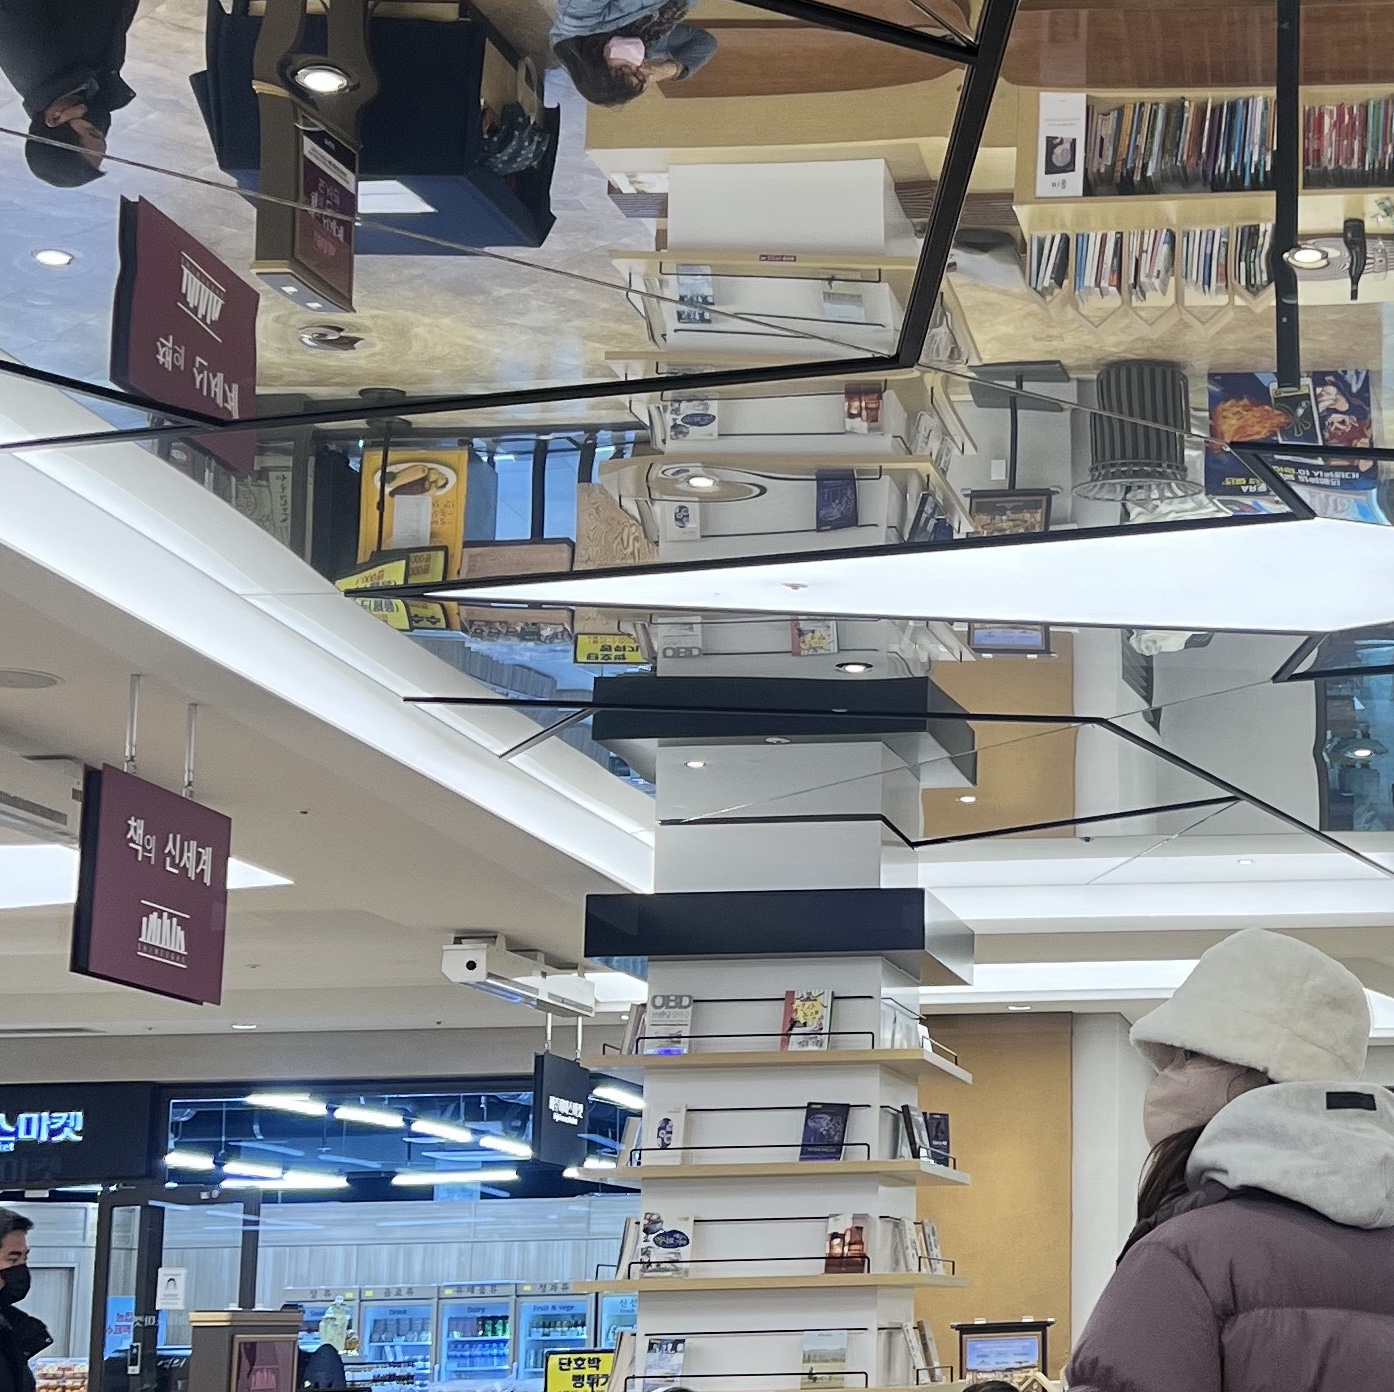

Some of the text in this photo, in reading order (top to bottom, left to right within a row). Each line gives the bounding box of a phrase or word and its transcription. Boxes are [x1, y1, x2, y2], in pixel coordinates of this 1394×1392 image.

[127, 816, 213, 886] 책의 신세계
[651, 994, 694, 1010] OBD
[558, 1356, 602, 1371] 단호박
